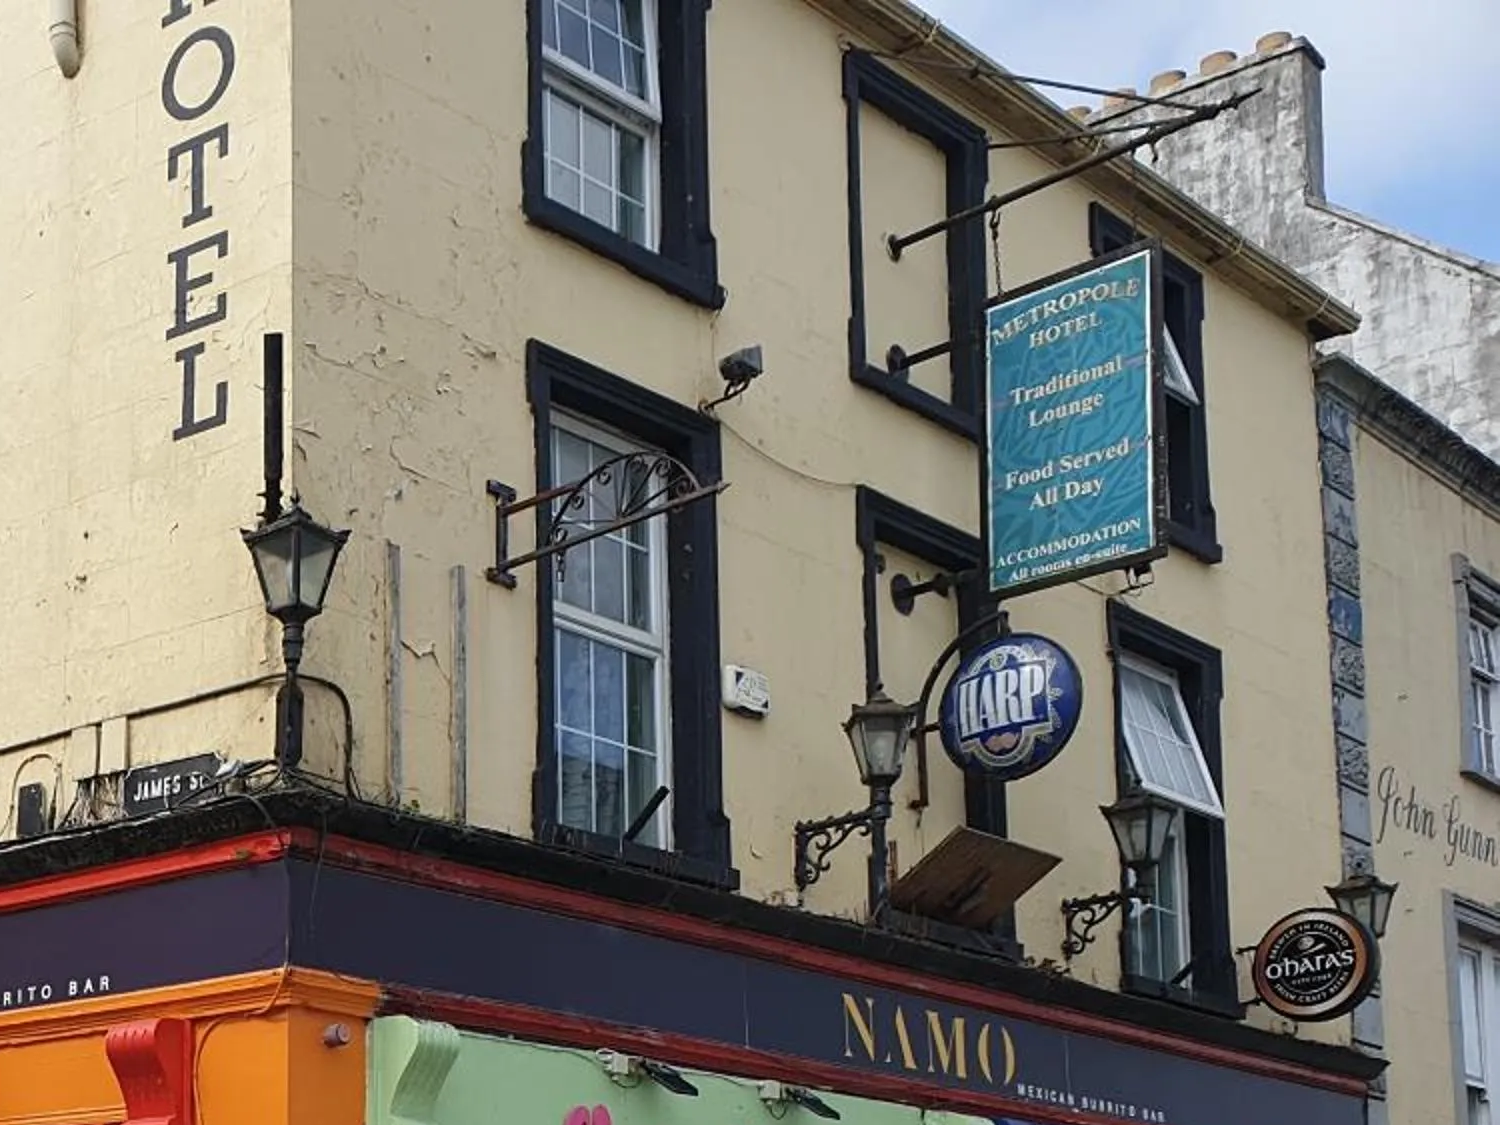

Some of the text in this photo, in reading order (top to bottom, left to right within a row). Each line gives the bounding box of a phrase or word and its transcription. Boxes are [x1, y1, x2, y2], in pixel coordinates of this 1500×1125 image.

[161, 0, 235, 441] OTEL
[991, 278, 1140, 346] METROPOLE
[1028, 312, 1102, 348] HOTEL
[1011, 355, 1122, 406] Traditional
[1028, 392, 1104, 428] Lounge
[1005, 437, 1129, 490] Food Served
[1028, 478, 1104, 510] All Day
[996, 518, 1140, 568] ACCOMMODATION
[1009, 567, 1028, 583] All
[1031, 559, 1072, 576] rooms
[959, 665, 1045, 737] HARP
[133, 775, 181, 802] JAMES
[1376, 766, 1498, 867] John Gunn
[68, 975, 111, 996] BAR
[842, 992, 1165, 1123] NAMO MEXICAN BURRITO BAR
